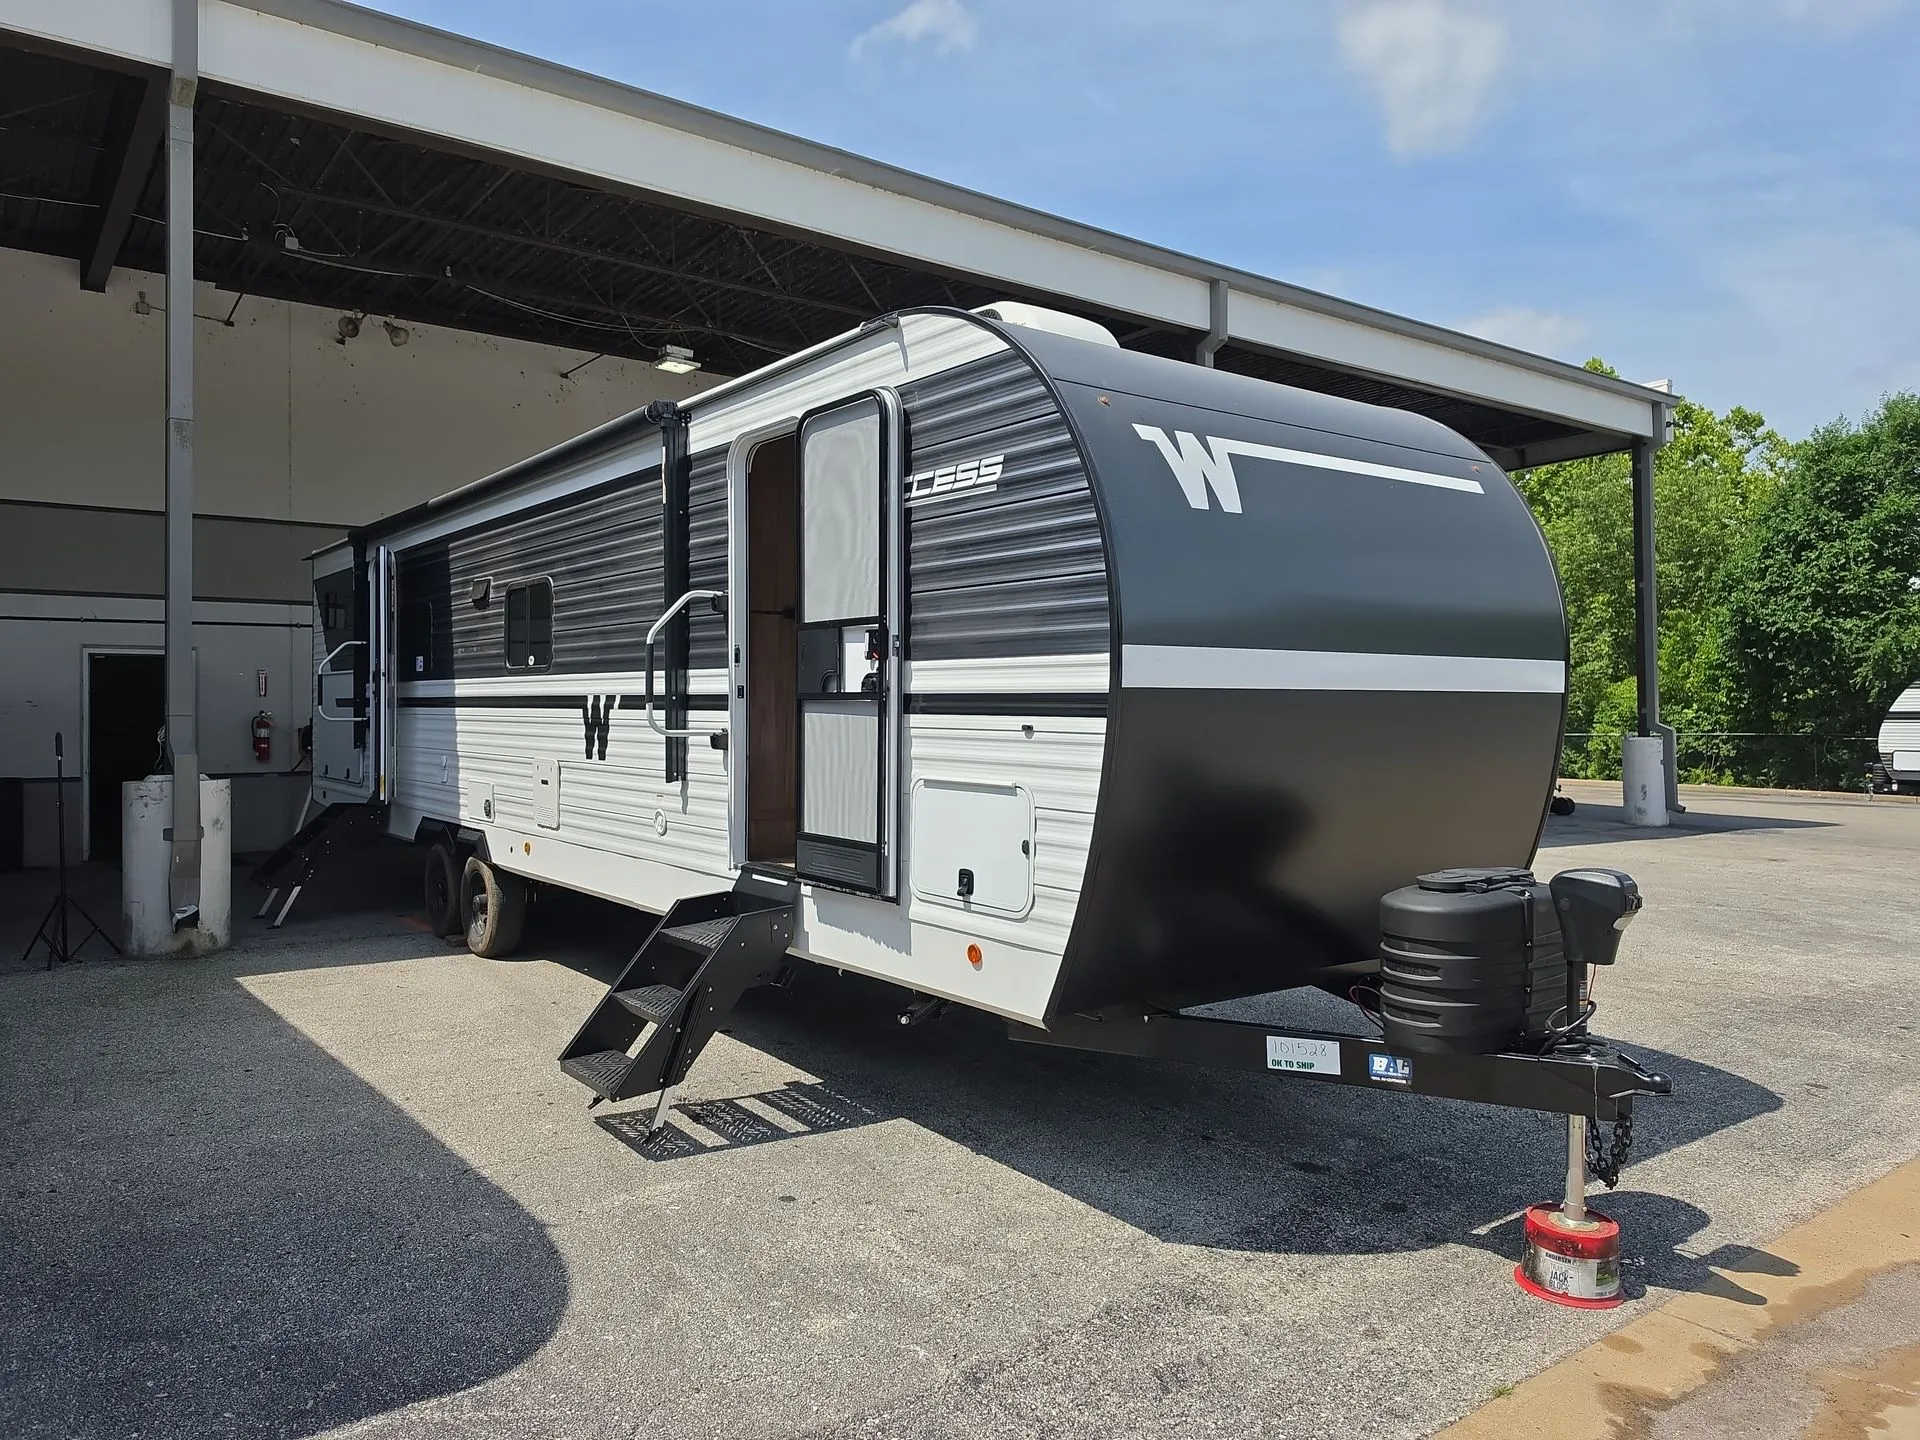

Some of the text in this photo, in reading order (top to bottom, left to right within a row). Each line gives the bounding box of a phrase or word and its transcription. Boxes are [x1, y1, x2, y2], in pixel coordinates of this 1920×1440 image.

[1273, 1040, 1327, 1057] 101528
[1271, 1058, 1315, 1070] OK TO SHIP
